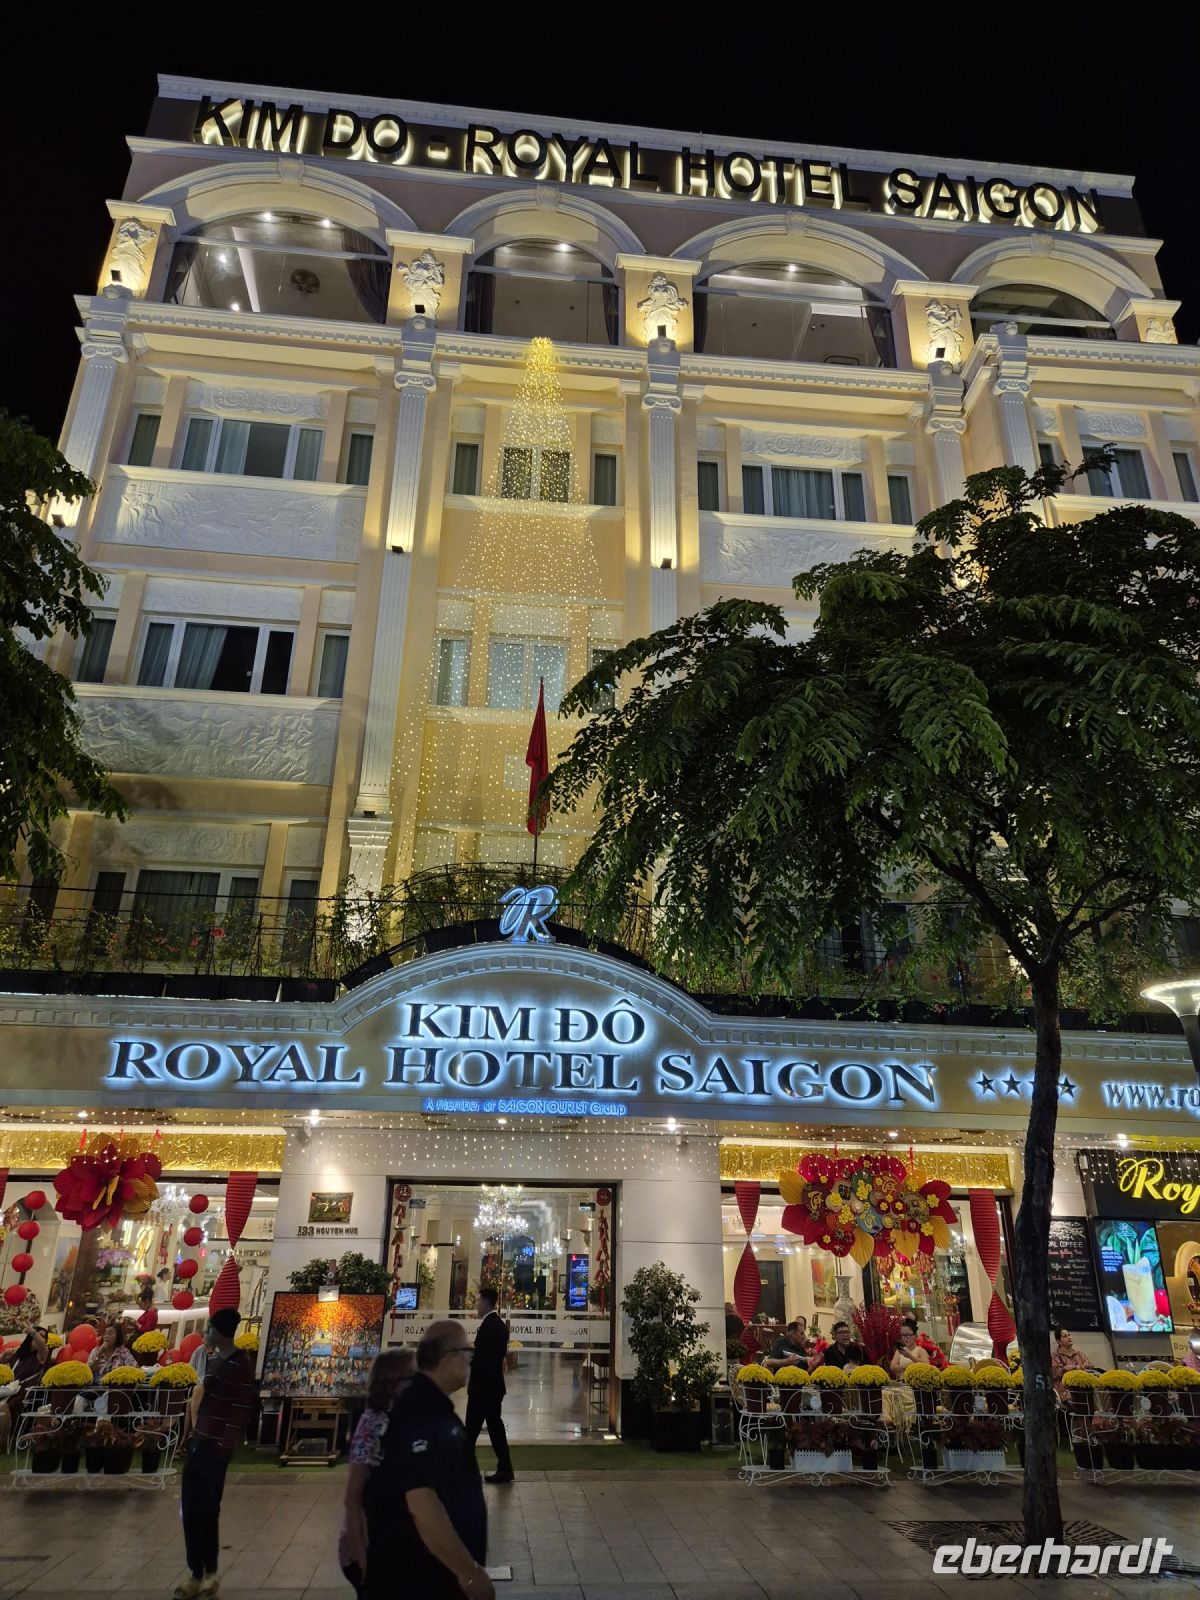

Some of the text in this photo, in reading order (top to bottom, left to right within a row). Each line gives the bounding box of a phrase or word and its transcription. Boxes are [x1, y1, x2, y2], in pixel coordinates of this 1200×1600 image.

[194, 95, 306, 154] KIM
[323, 108, 412, 164] DO
[464, 123, 659, 191] ROYAL
[675, 146, 871, 210] HOTEL
[884, 167, 1105, 233] SAIGON
[402, 998, 645, 1044] KIM ĐÔ
[106, 1040, 938, 1103] ROYAL HOTEL SAIGON
[425, 1098, 435, 1111] A
[498, 1099, 588, 1114] SAIGONTOURIST
[590, 1102, 626, 1116] Group
[511, 1325, 533, 1335] ROYAL
